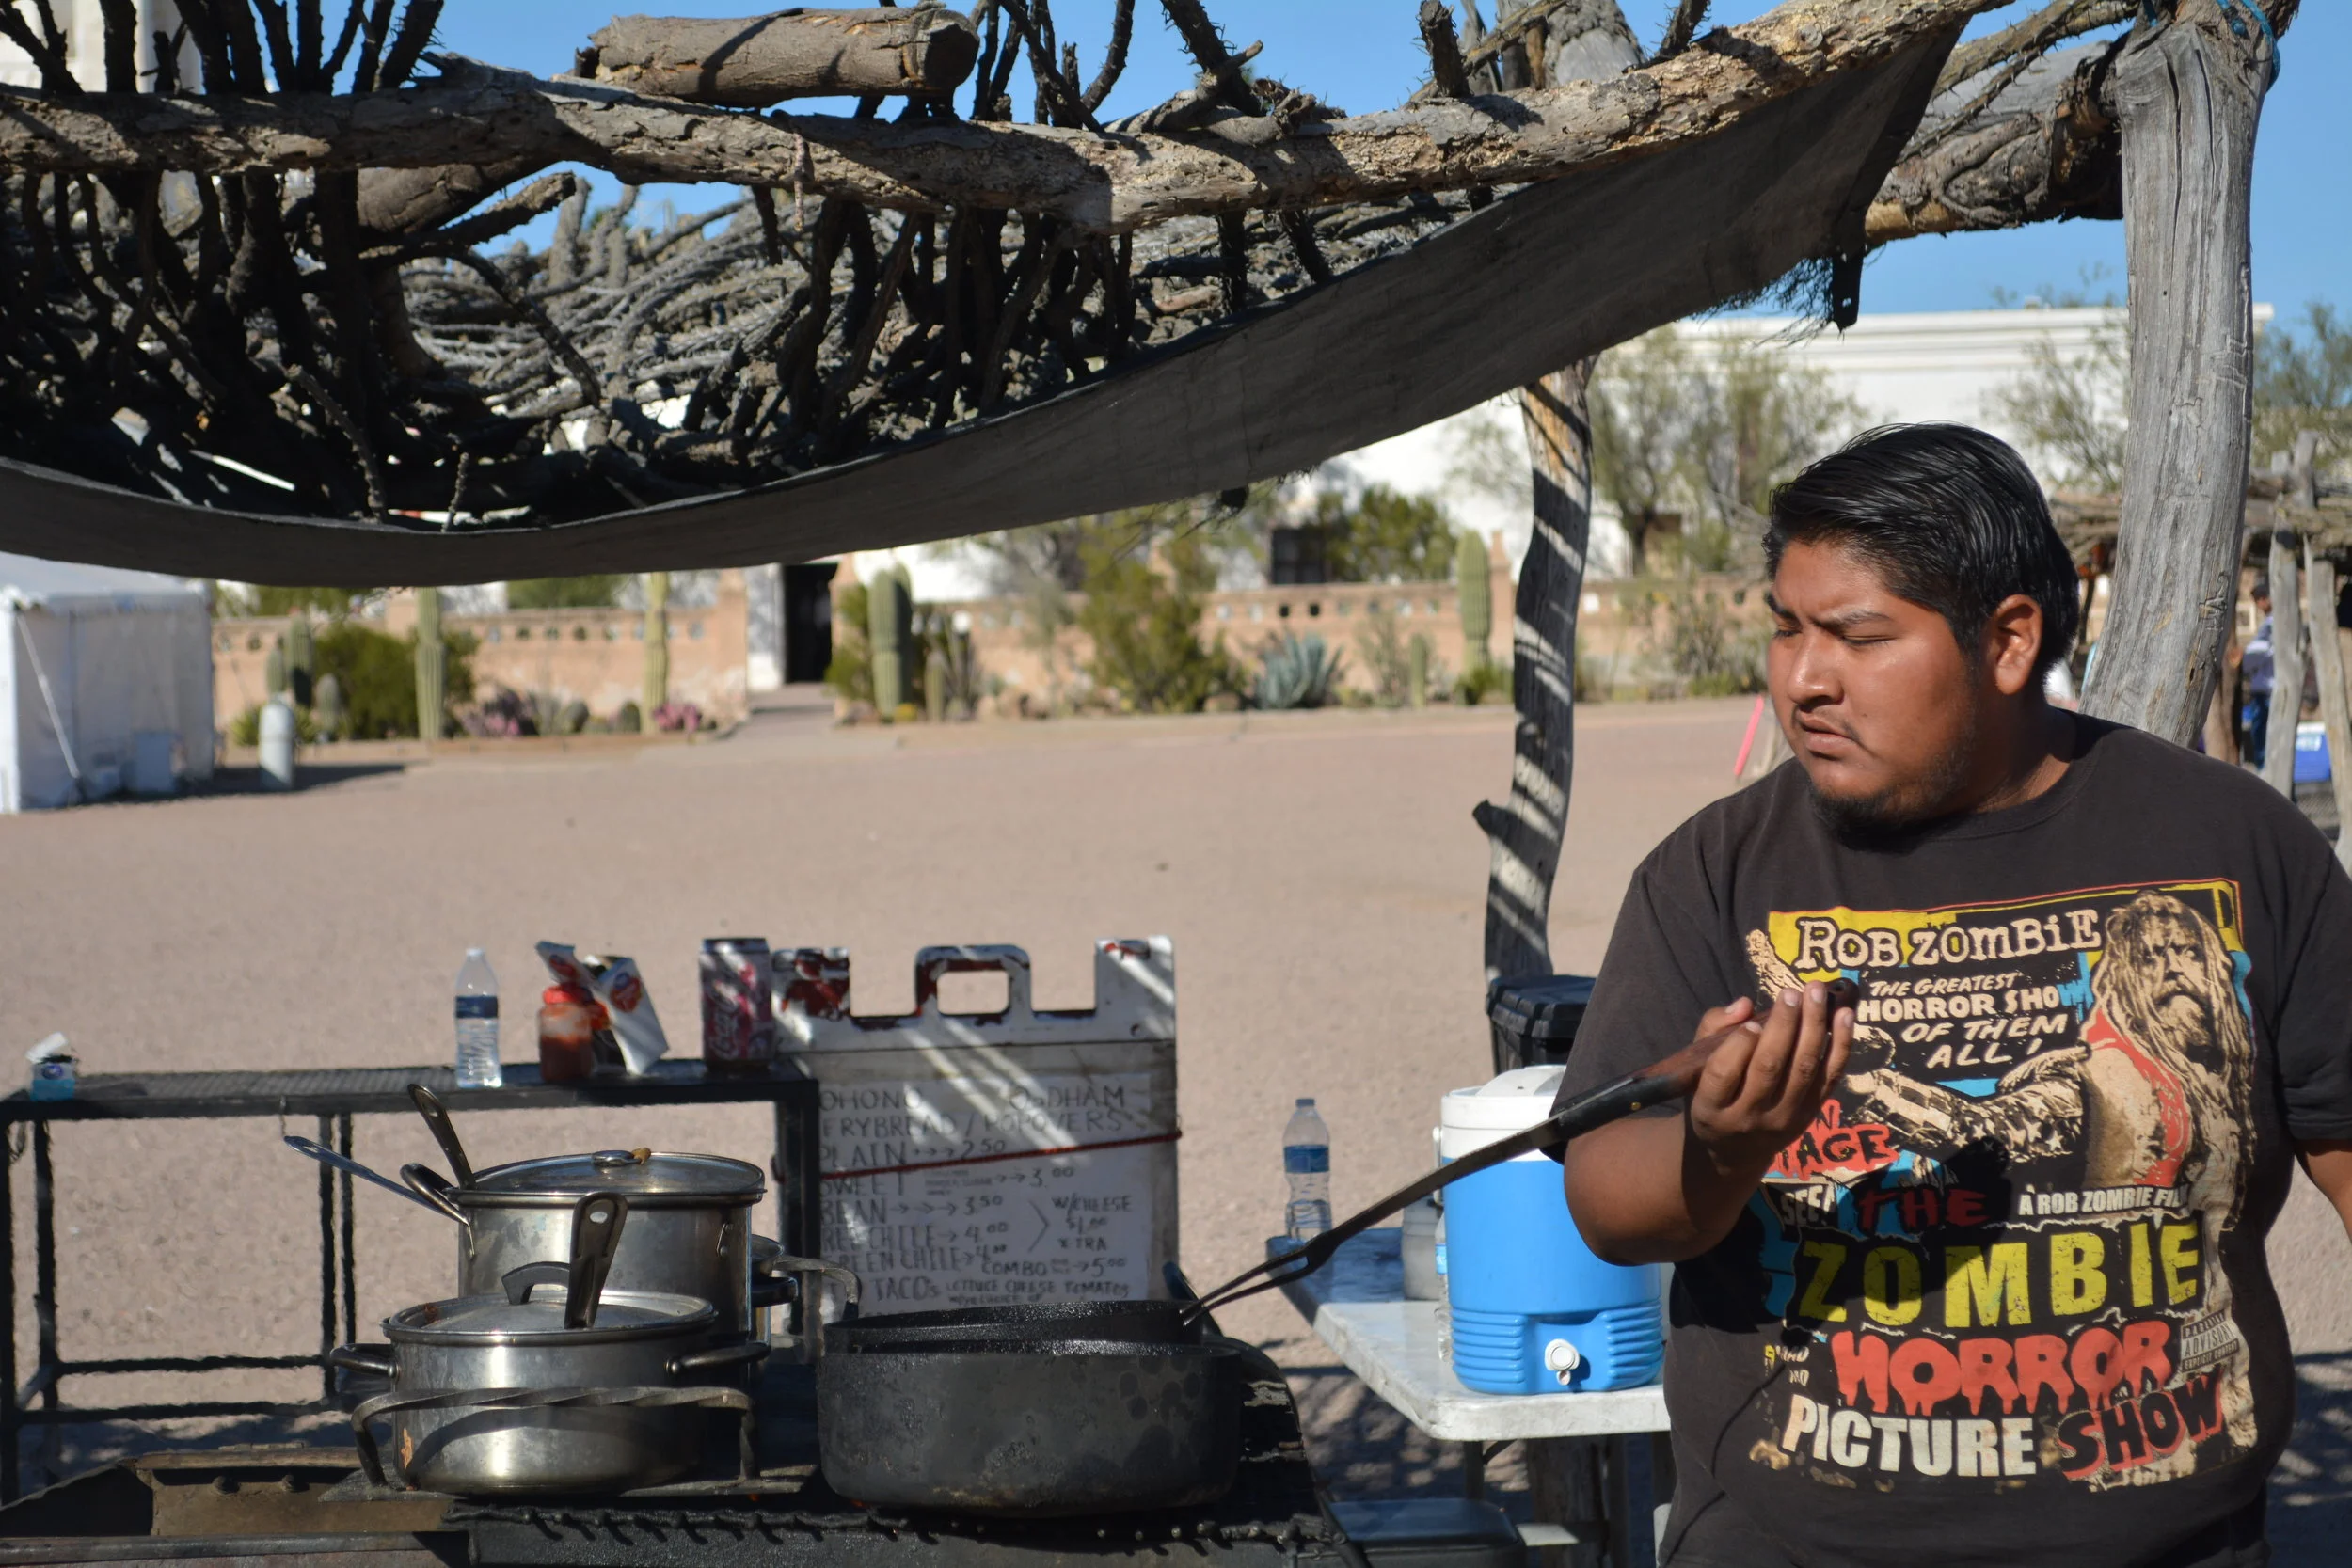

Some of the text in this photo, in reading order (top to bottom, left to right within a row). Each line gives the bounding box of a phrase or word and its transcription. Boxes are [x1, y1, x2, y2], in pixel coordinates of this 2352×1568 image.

[1794, 919, 1900, 969] ROB
[1869, 973, 2017, 997] THE GREATEST
[1857, 991, 1996, 1022] HORROR
[1901, 1013, 2068, 1043] OF THEM
[1858, 1187, 1992, 1230] THE
[2018, 1194, 2035, 1215] A
[2037, 1191, 2079, 1215] ROB
[2081, 1186, 2154, 1212] ZOMBIE
[825, 1252, 894, 1274] REEN
[1798, 1222, 2200, 1328] ZOMBIE
[1830, 1321, 2171, 1416] HORROR
[1782, 1370, 2226, 1480] PICTURE SHOW
